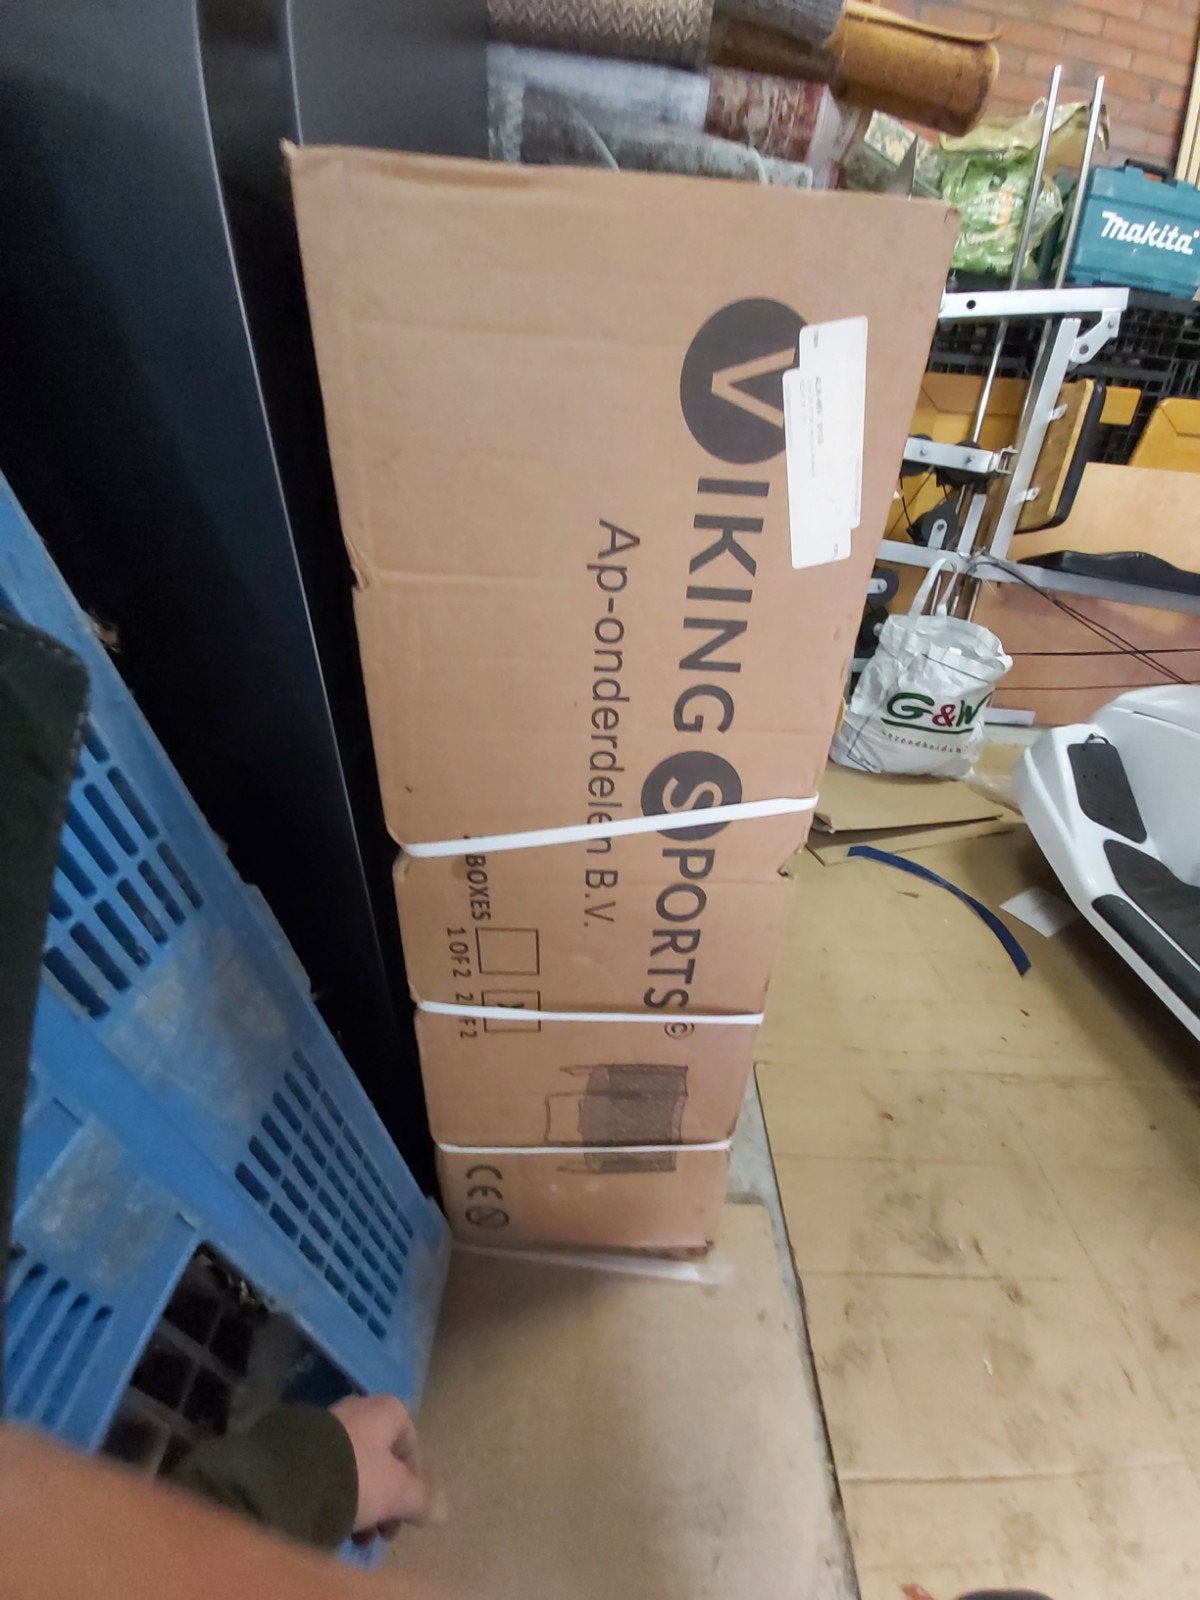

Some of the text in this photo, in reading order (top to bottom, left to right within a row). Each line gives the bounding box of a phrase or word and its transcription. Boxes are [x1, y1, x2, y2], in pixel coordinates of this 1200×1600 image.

[584, 517, 641, 928] Ap-onderdelen B.V.
[672, 345, 797, 734] VIKING
[465, 853, 492, 921] BOXES
